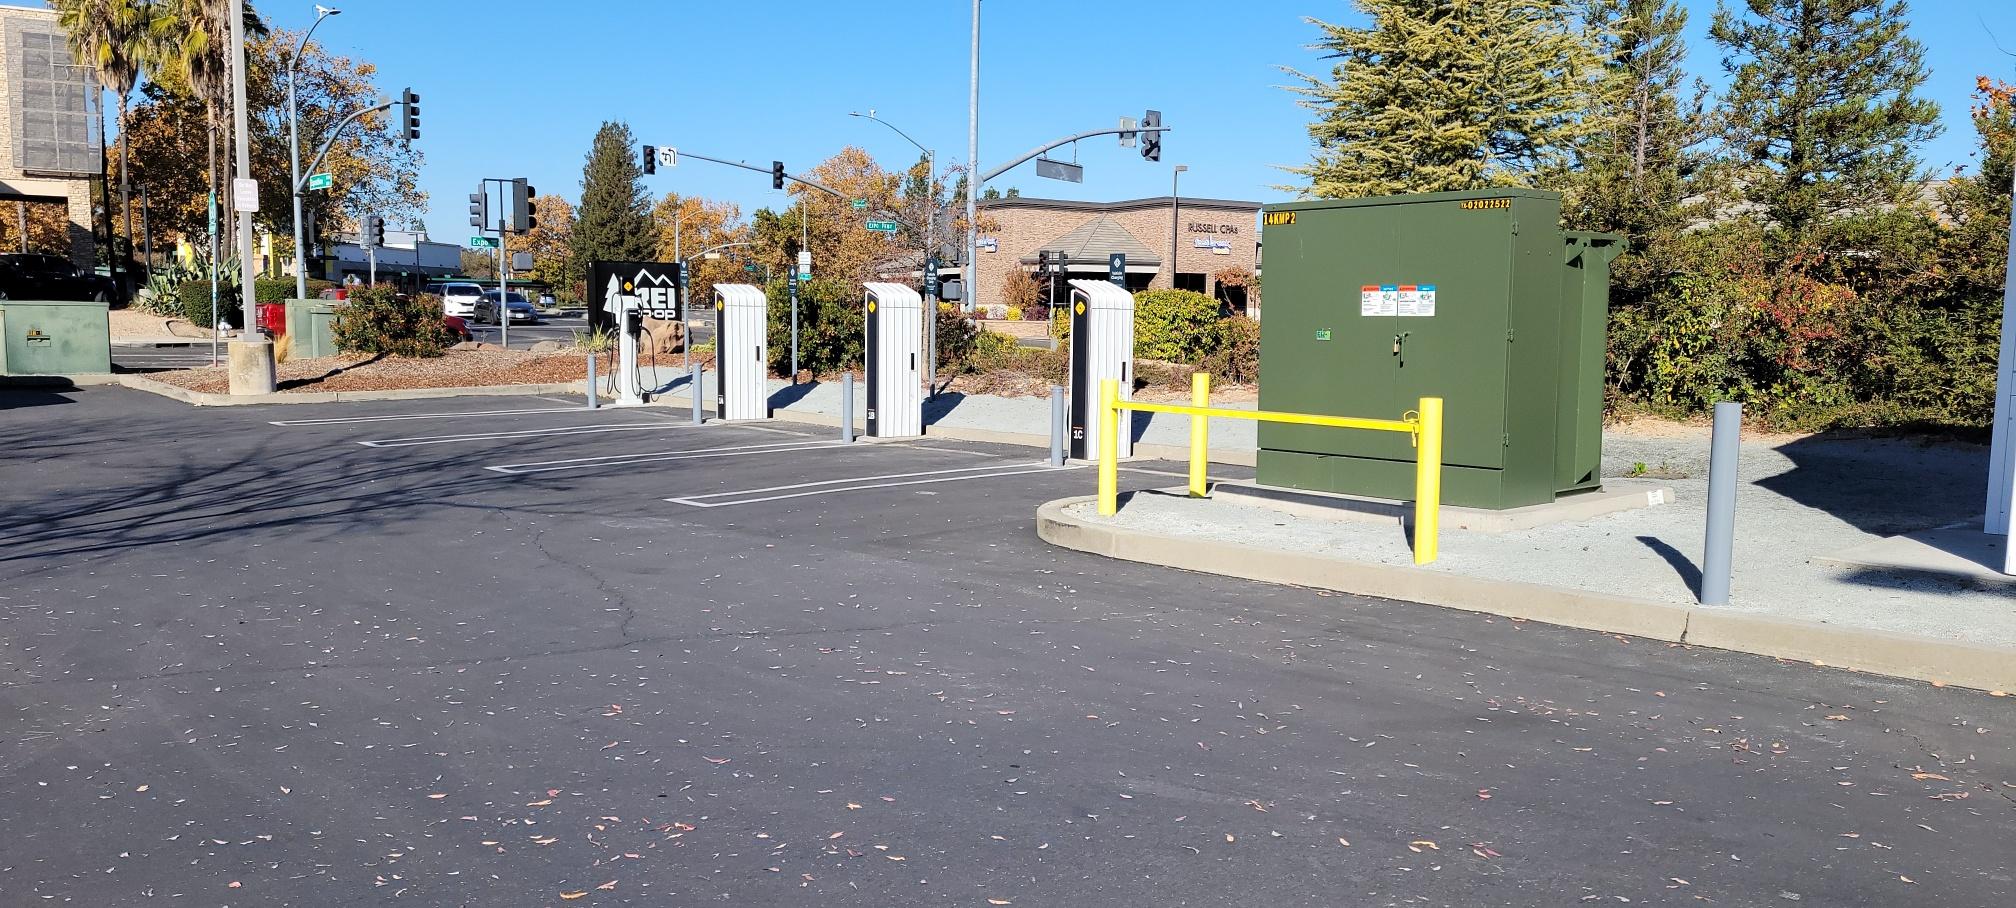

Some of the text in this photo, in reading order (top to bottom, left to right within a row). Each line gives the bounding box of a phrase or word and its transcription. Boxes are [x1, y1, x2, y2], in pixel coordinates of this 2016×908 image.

[1263, 212, 1296, 225] 14KMP2
[1188, 223, 1238, 234] RUSSELL CPAs
[472, 238, 489, 246] Expo
[634, 287, 676, 309] REI
[1073, 429, 1083, 440] 1C
